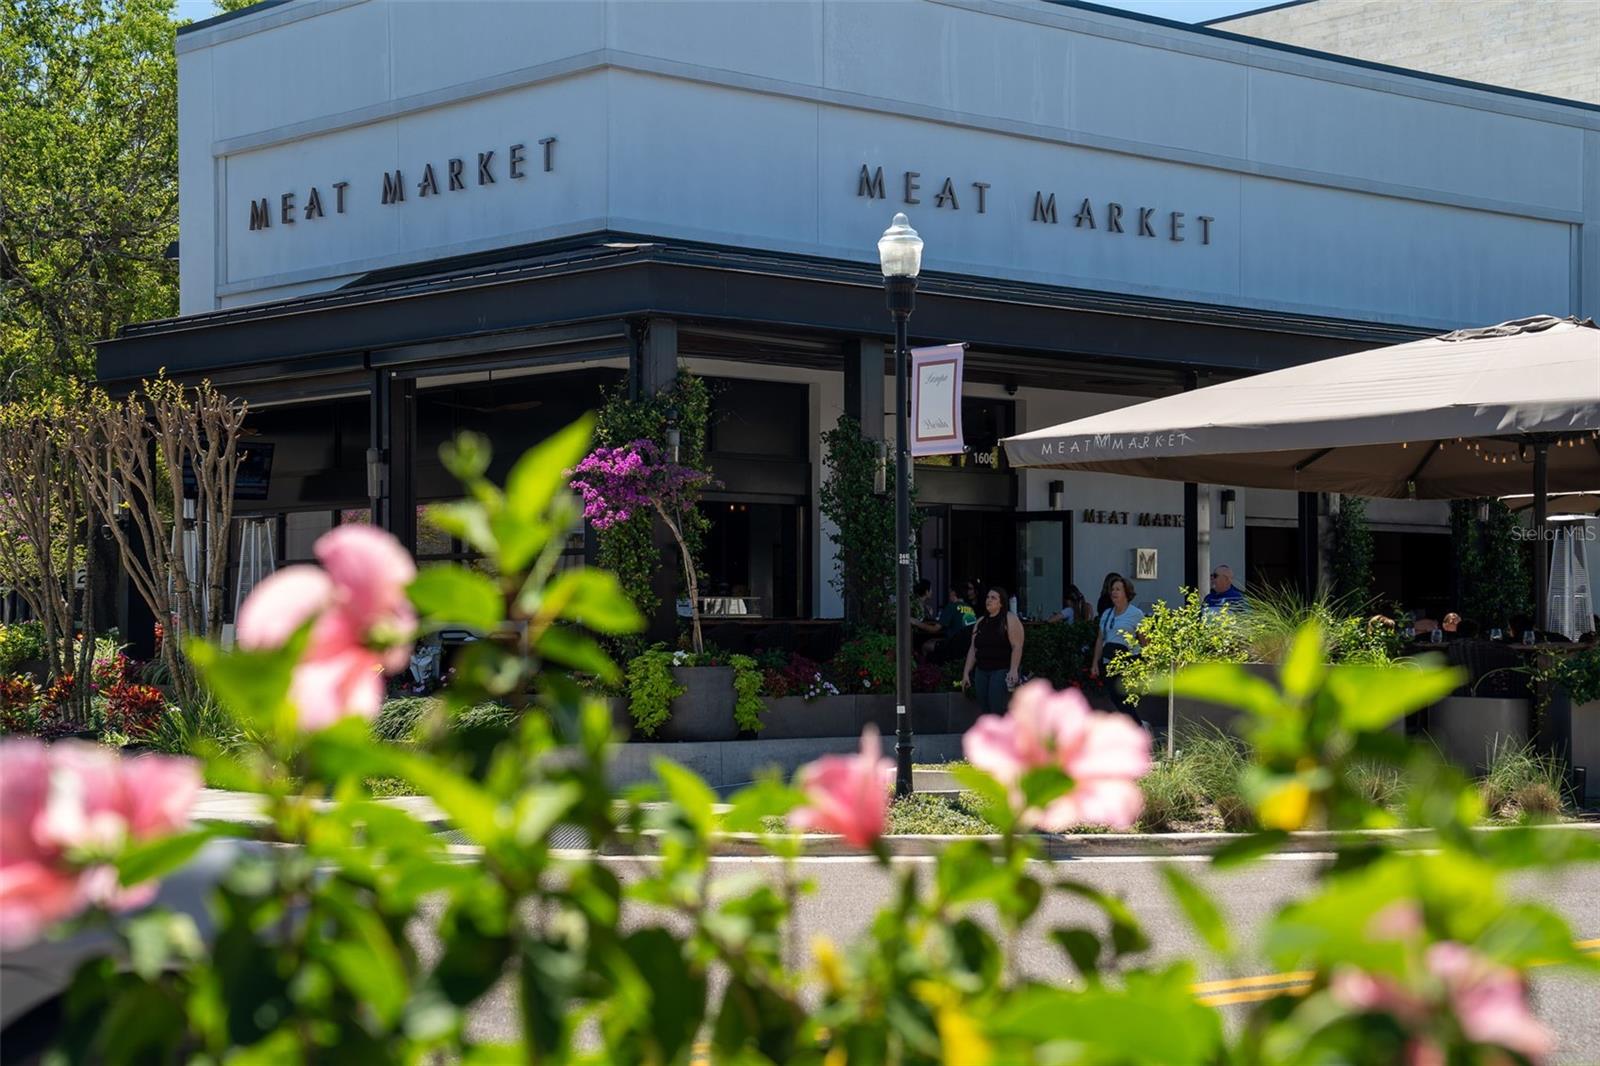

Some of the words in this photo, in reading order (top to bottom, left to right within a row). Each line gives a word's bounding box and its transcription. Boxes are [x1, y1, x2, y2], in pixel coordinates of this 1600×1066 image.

[249, 181, 350, 231] MEAT
[380, 136, 558, 205] MARKET
[857, 163, 991, 214] MEAT
[1032, 190, 1215, 245] MARKET
[1040, 439, 1092, 456] MEAT
[1111, 432, 1191, 450] MARKET
[973, 452, 996, 465] 1606
[1082, 508, 1130, 525] MEAT
[1137, 511, 1185, 528] MARK
